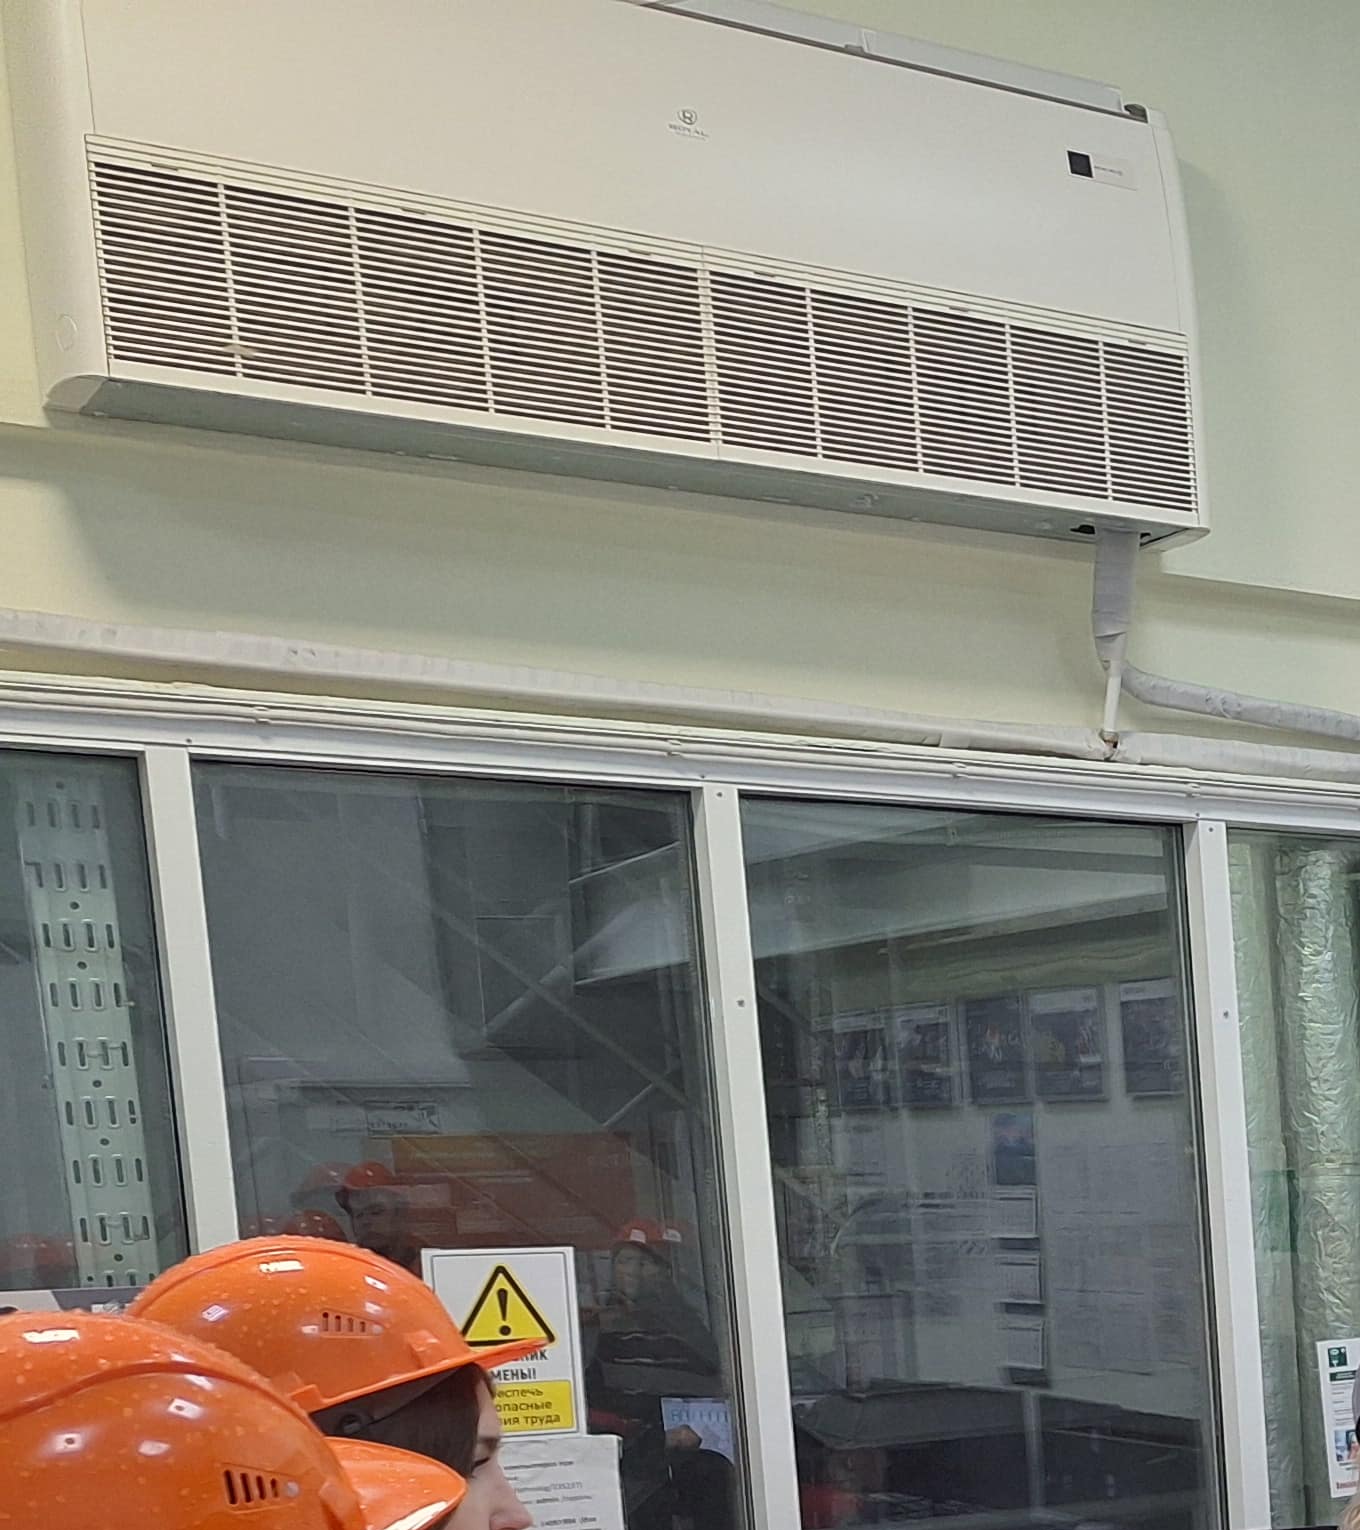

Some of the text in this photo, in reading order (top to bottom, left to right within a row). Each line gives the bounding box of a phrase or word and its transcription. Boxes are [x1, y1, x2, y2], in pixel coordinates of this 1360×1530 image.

[490, 1368, 537, 1381] МЕНЫ!
[496, 1401, 552, 1412] опасные
[523, 1414, 561, 1426] труда
